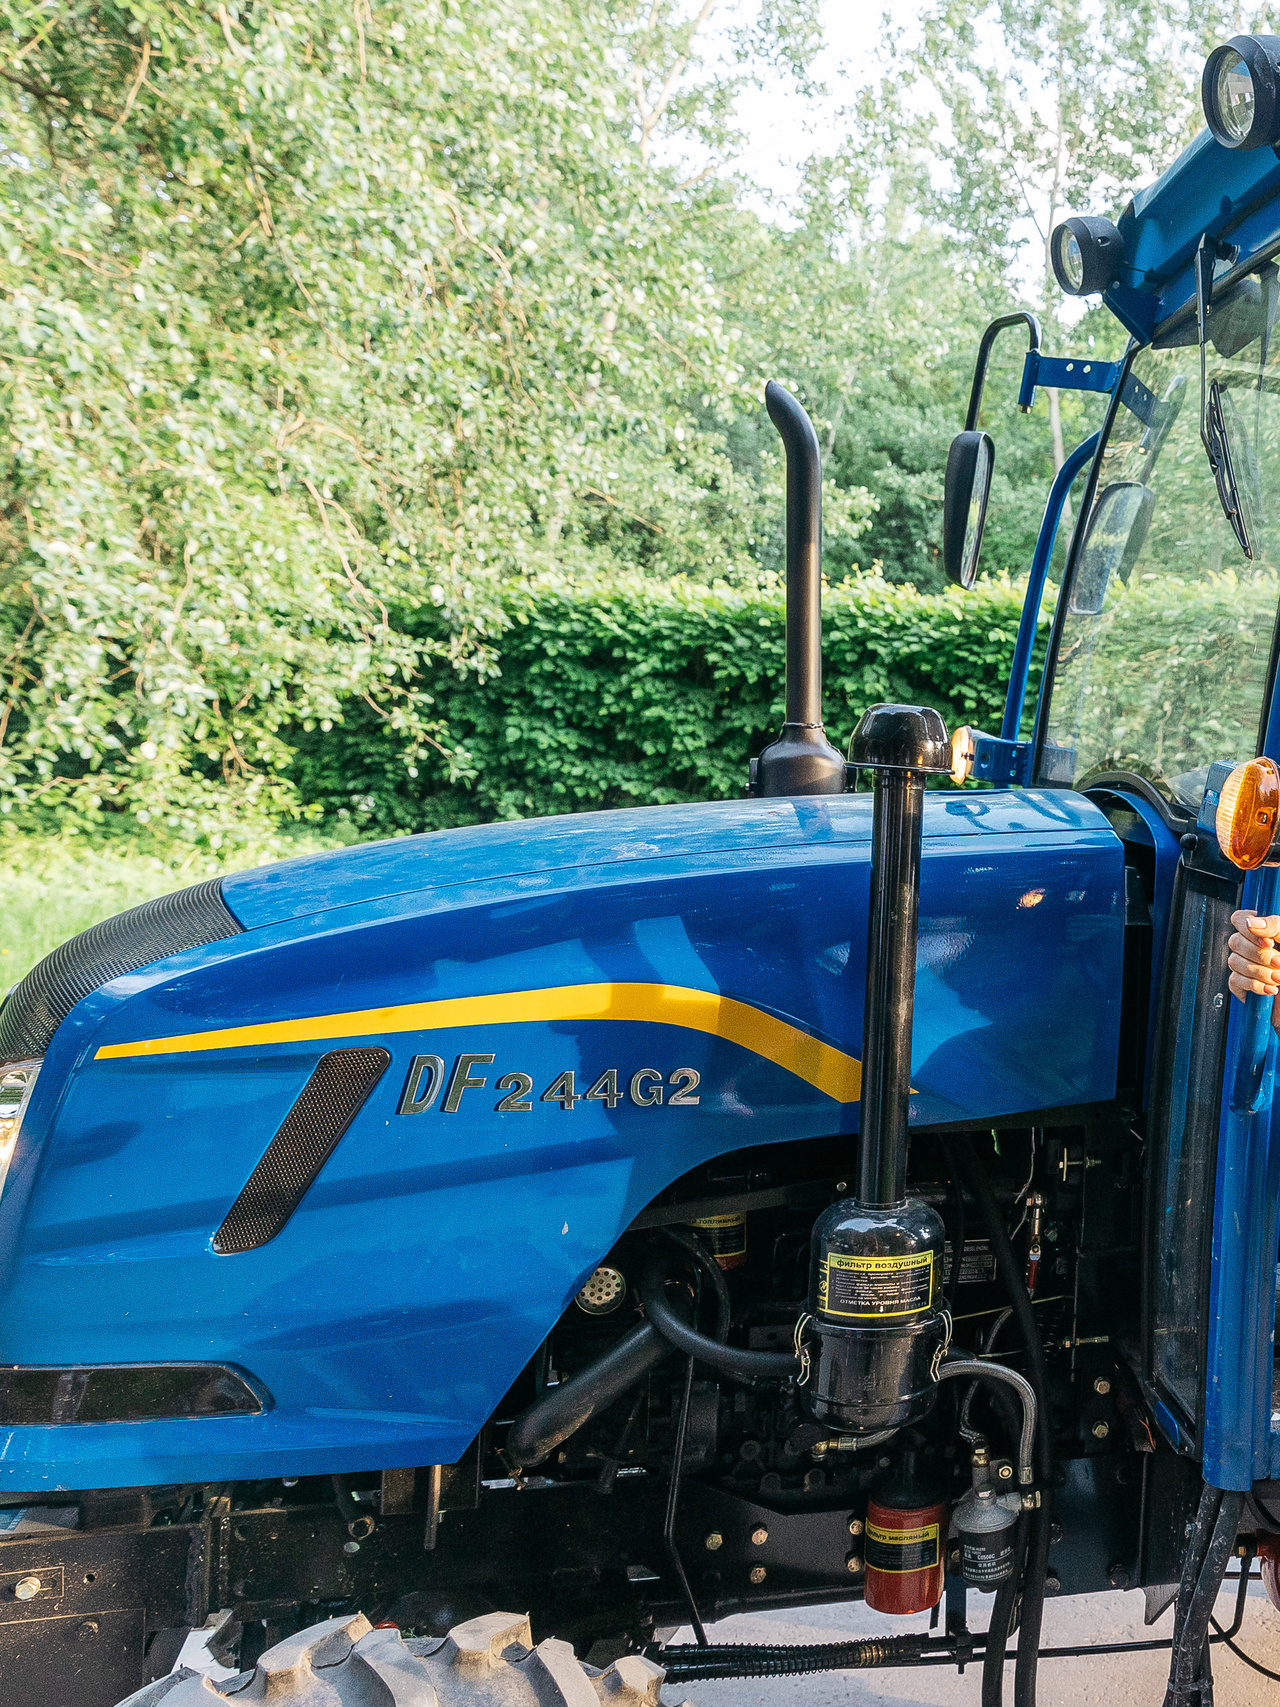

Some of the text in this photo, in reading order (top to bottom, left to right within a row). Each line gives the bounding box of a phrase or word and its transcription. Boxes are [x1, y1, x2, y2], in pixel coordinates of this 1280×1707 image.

[836, 1259, 873, 1270] фильтр
[874, 1256, 929, 1271] воздушный
[900, 1296, 921, 1304] МАСЛА
[888, 1530, 930, 1541] масляный
